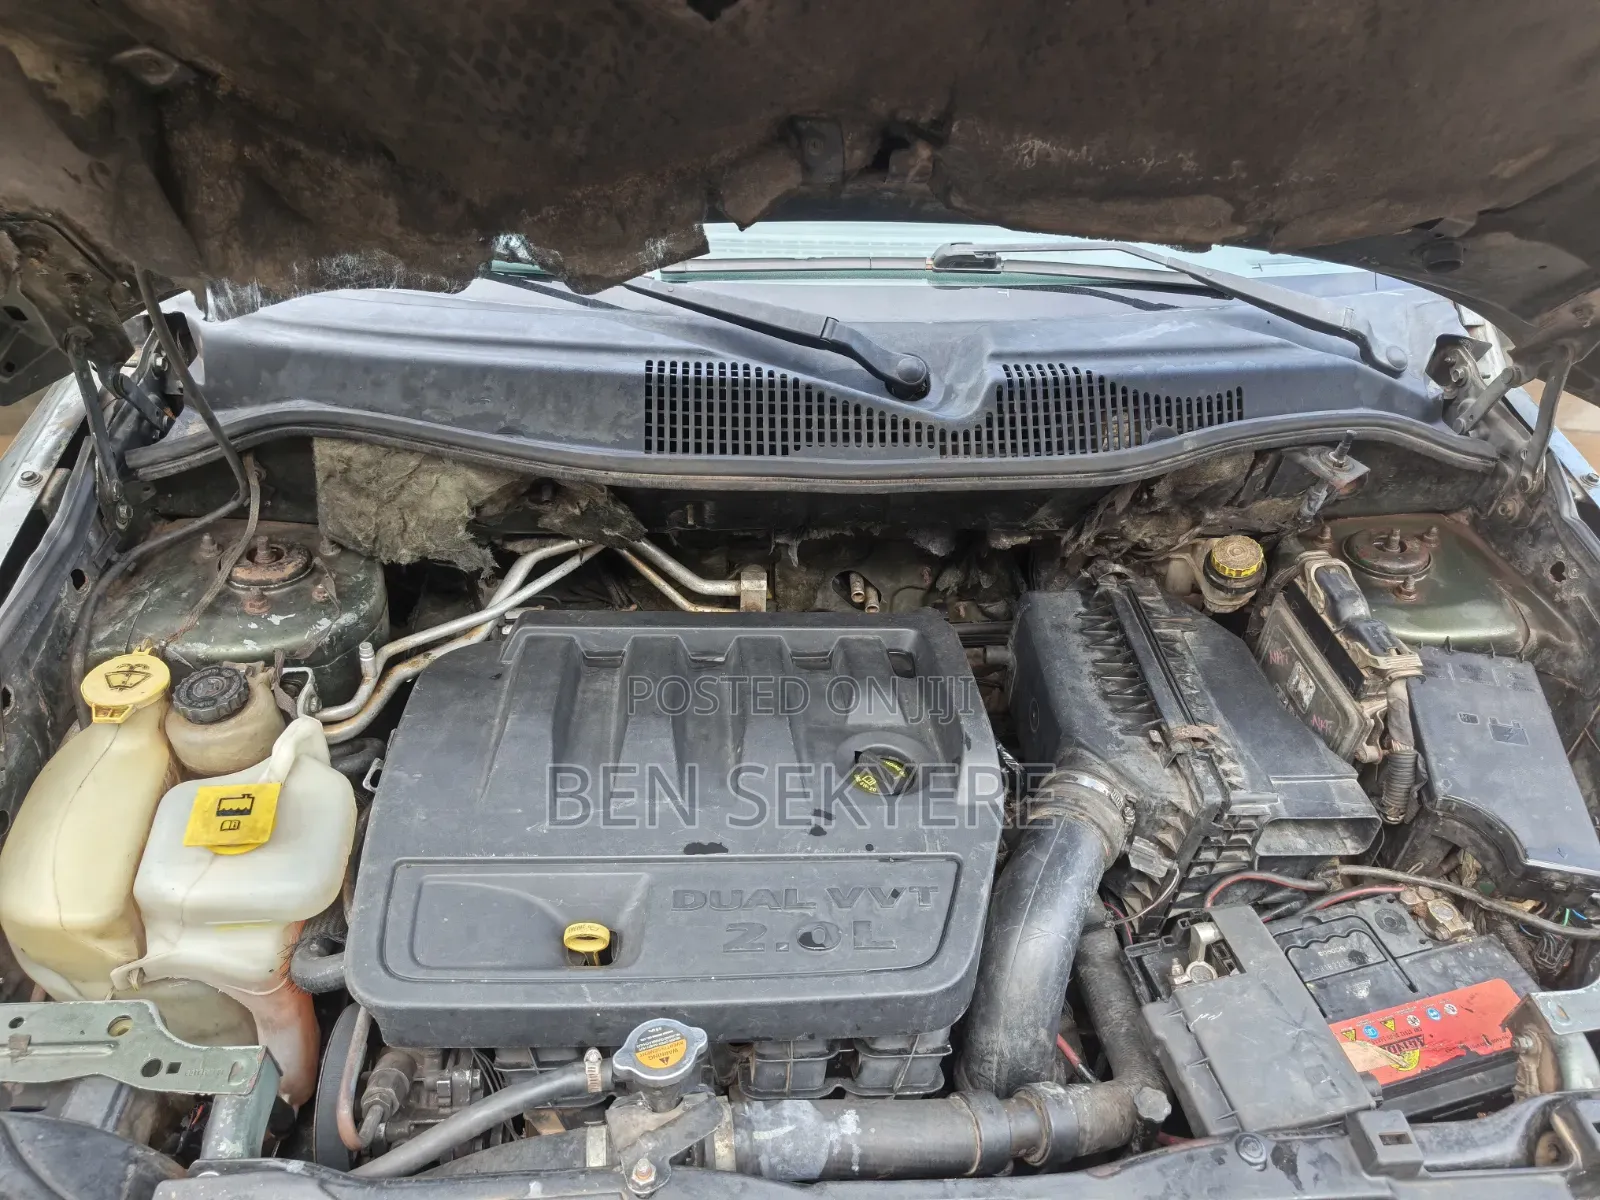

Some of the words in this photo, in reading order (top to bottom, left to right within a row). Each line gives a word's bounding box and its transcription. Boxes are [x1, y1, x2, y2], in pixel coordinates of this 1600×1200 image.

[671, 889, 817, 911] DUAL
[825, 886, 939, 909] VVT
[723, 920, 897, 952] 2.0L
[648, 1048, 679, 1061] WARNING
